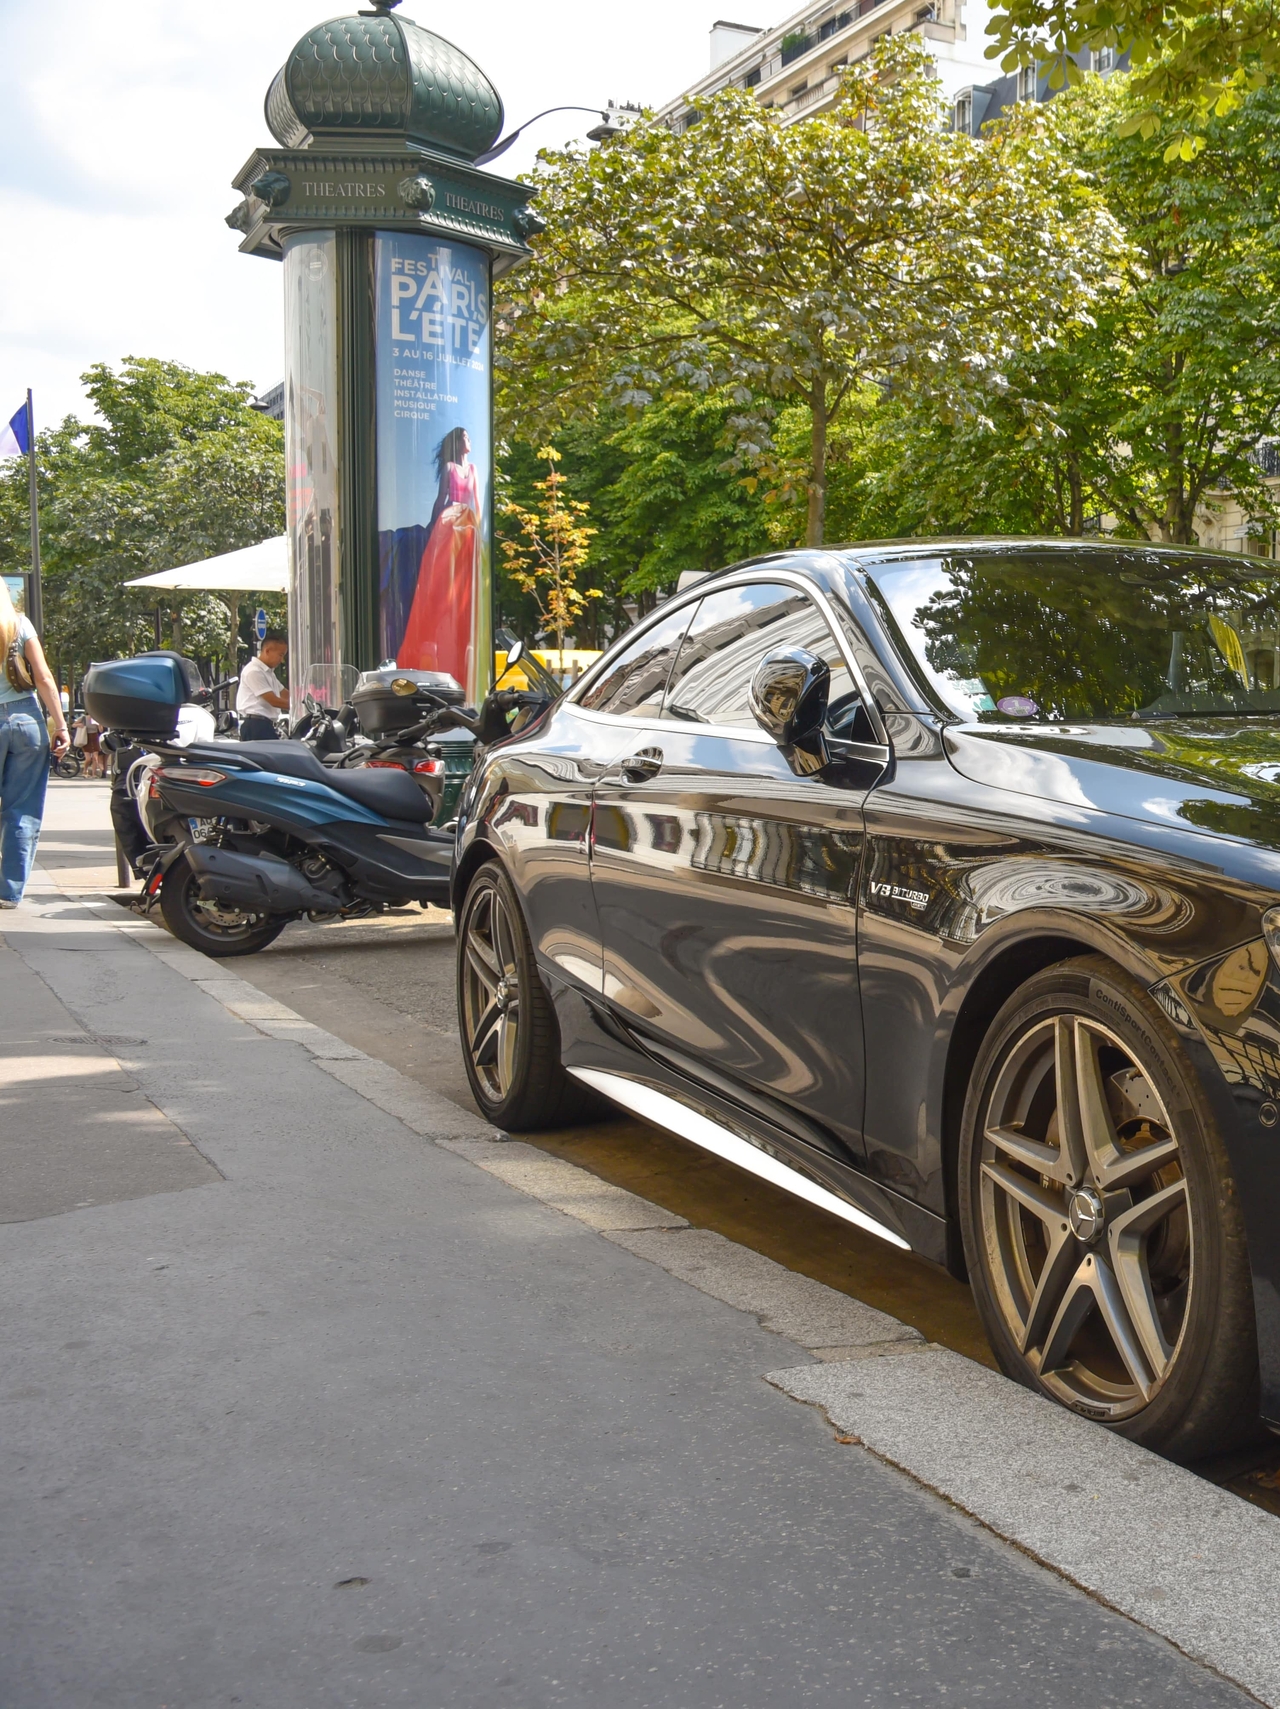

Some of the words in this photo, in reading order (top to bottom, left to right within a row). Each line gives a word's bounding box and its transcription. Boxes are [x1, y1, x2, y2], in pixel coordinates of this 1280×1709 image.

[302, 182, 386, 197] THEATRES
[445, 192, 505, 222] THEATRES
[391, 271, 487, 325] PARIS
[392, 348, 399, 357] 3
[403, 349, 419, 359] AU
[423, 351, 433, 360] 16
[437, 354, 470, 367] JUILLET
[394, 369, 426, 378] DANSE
[394, 379, 437, 390] THÉÂTRE
[394, 390, 458, 403] INSTALLATION
[394, 400, 436, 410] MUSIQUE
[394, 410, 430, 420] CIRQUE
[870, 881, 891, 897] V8
[892, 886, 929, 902] BITURBO
